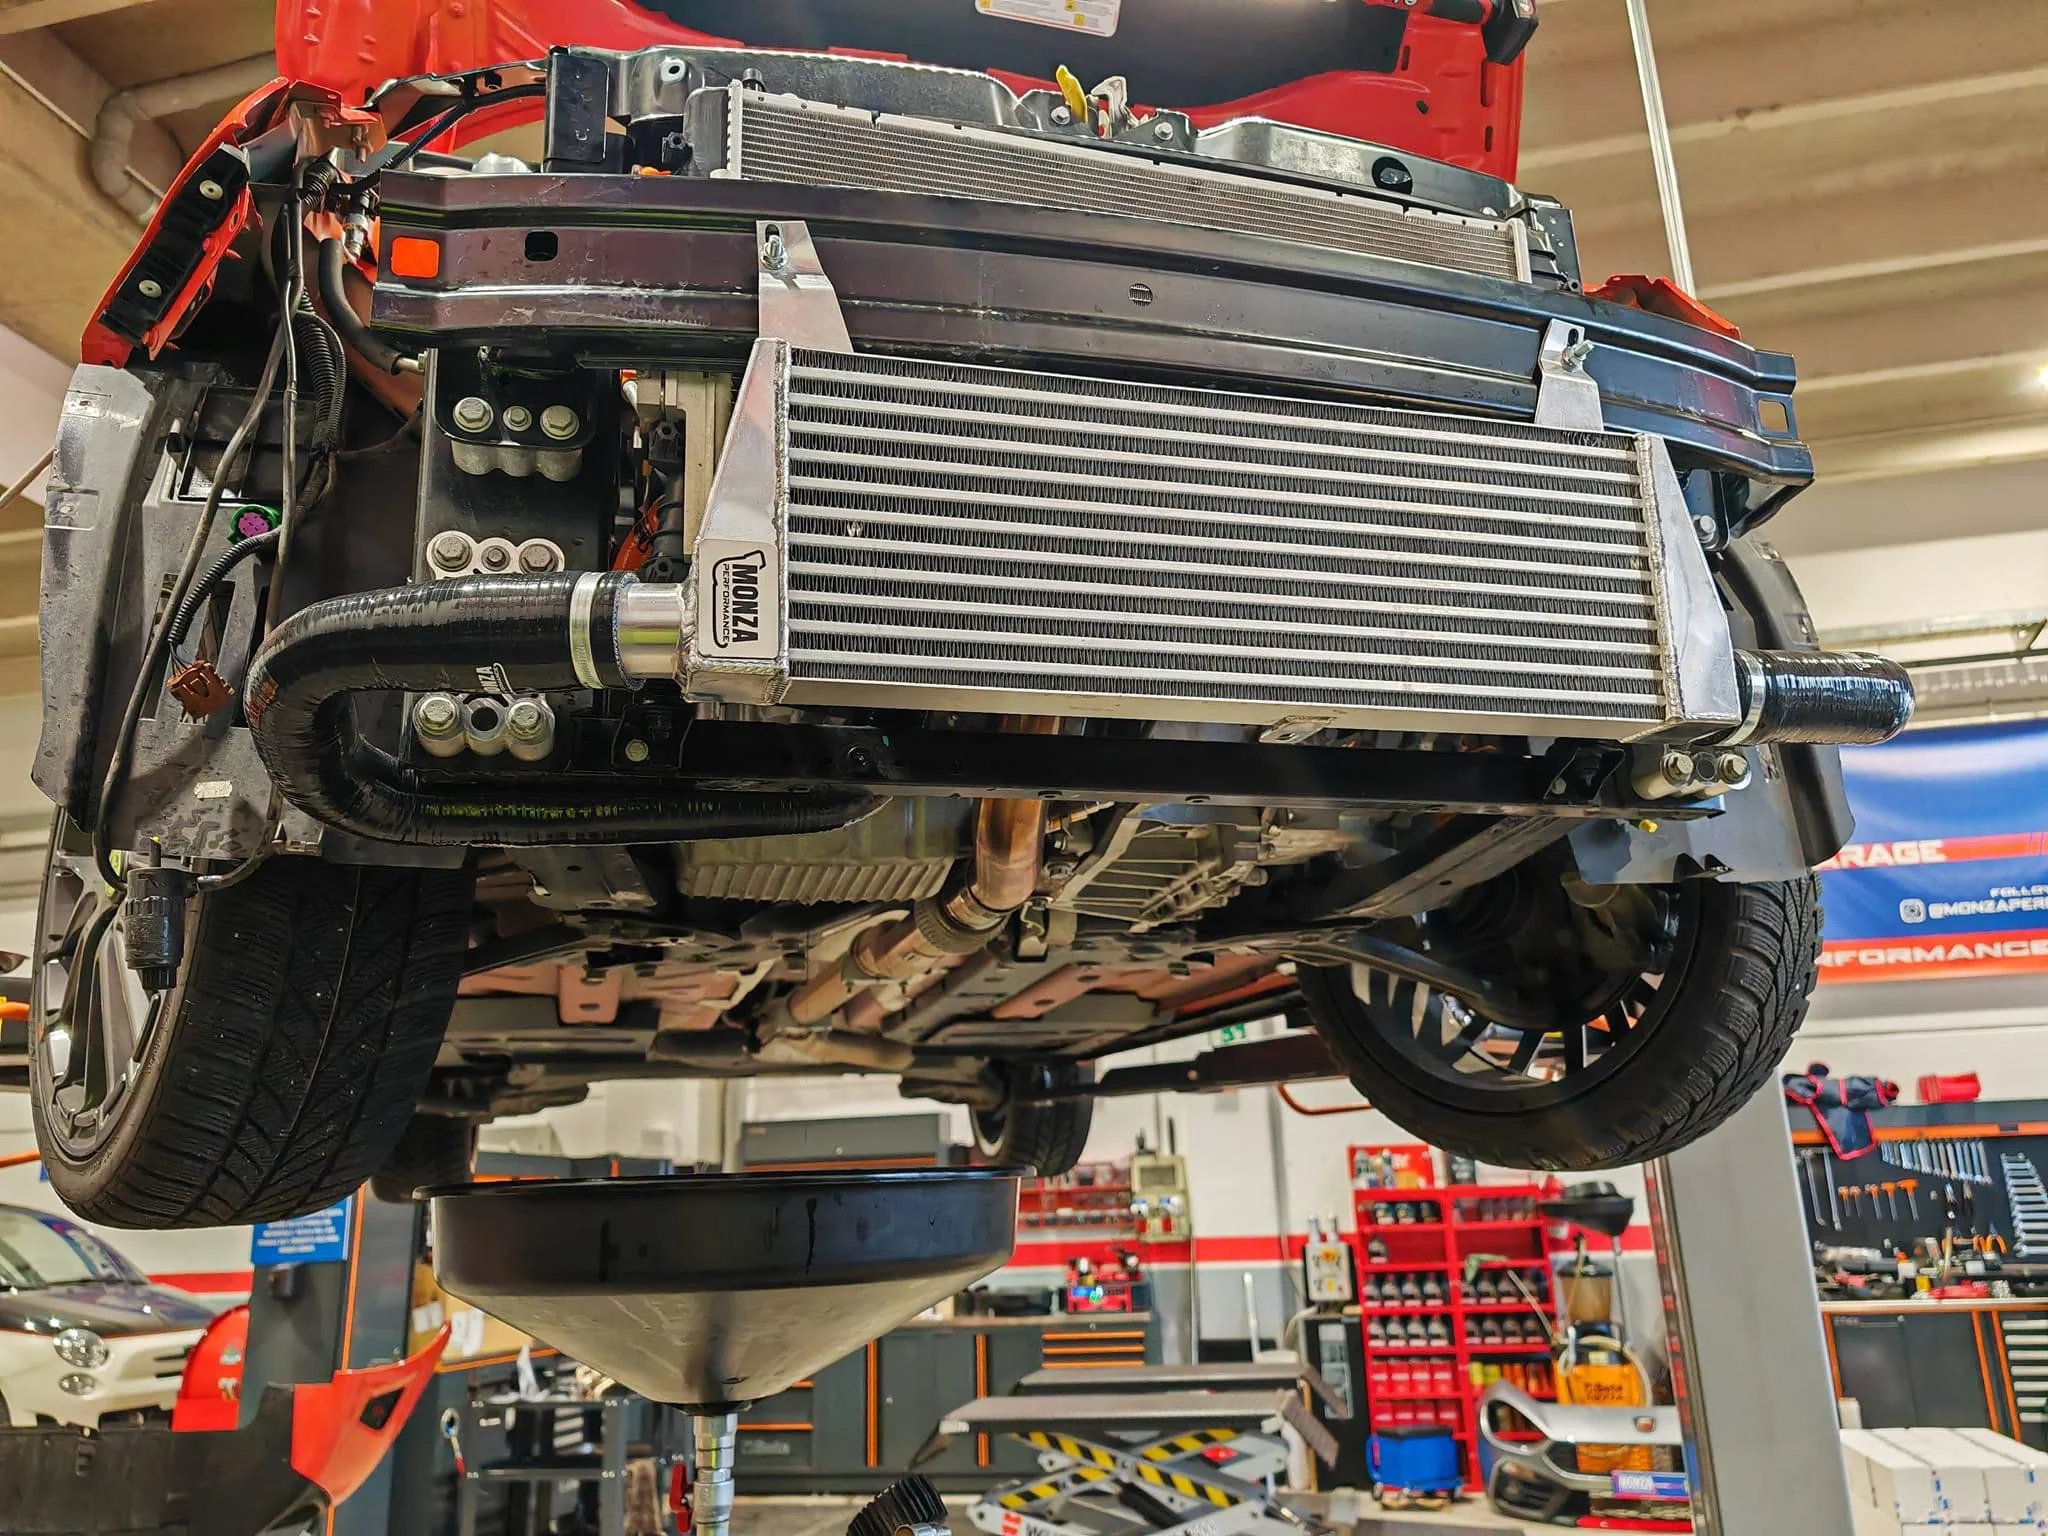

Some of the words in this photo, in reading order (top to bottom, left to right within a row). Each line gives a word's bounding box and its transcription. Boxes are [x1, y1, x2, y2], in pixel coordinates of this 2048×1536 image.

[722, 563, 730, 642] PERFORMANCE
[732, 564, 758, 642] MONZA
[475, 666, 501, 694] ONZA
